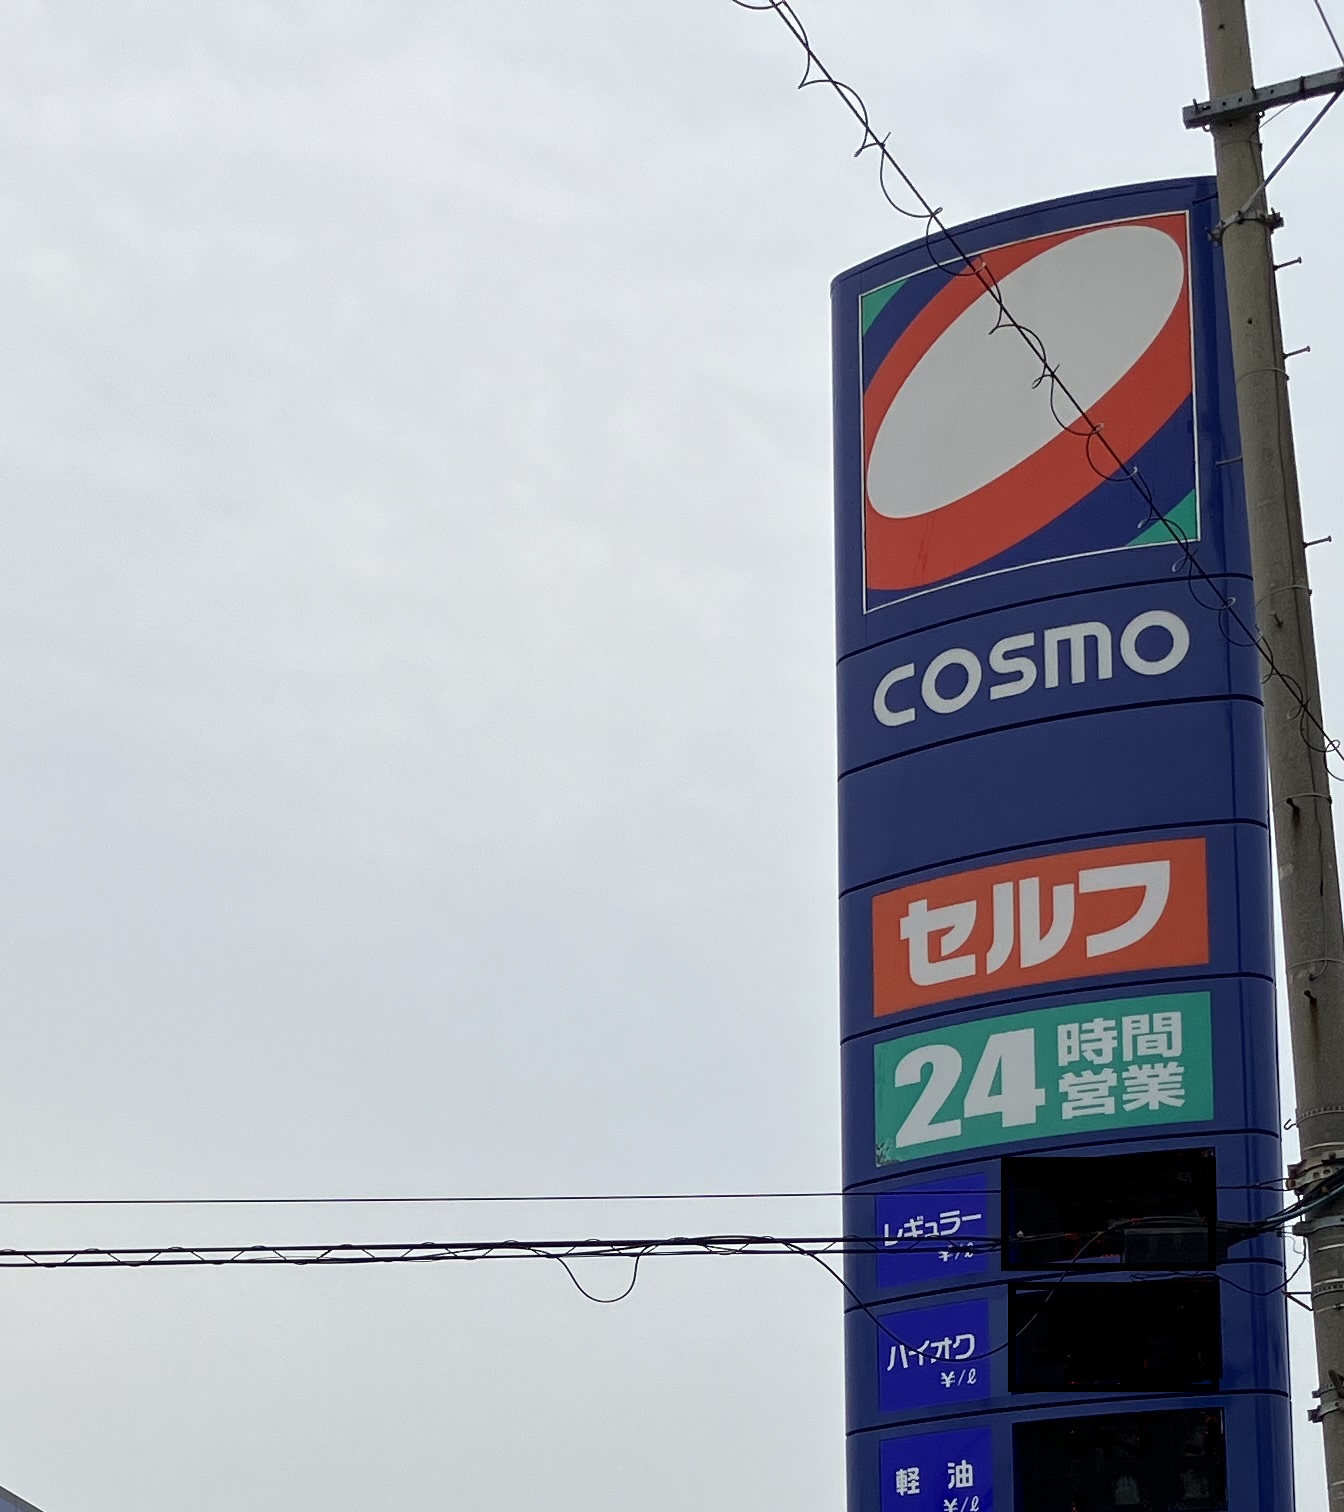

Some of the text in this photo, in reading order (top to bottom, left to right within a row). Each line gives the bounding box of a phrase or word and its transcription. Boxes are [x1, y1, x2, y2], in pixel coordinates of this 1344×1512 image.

[873, 611, 1190, 726] COSMO
[900, 860, 1171, 988] セルフ
[1057, 1011, 1183, 1067] 時間
[894, 1027, 1045, 1149] 24
[1058, 1062, 1185, 1119] 営業
[884, 1210, 982, 1246] レギュラー
[887, 1334, 975, 1371] ハイオク
